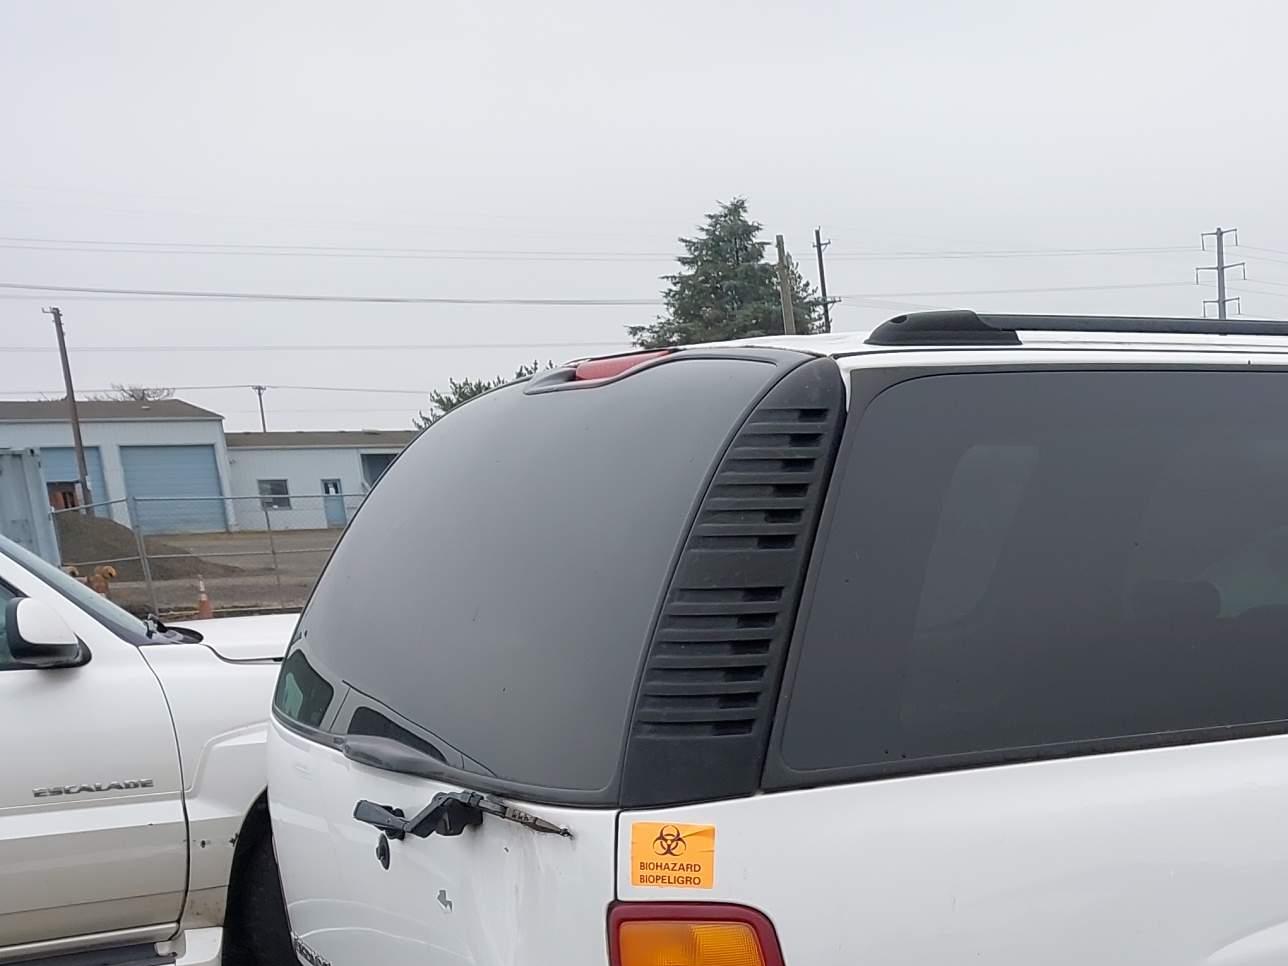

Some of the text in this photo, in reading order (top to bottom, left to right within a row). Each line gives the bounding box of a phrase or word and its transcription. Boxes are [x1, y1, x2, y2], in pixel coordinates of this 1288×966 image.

[32, 778, 154, 798] ESCALADE
[639, 861, 702, 873] BIOHAZARD
[639, 874, 702, 886] BIOPELIGRO
